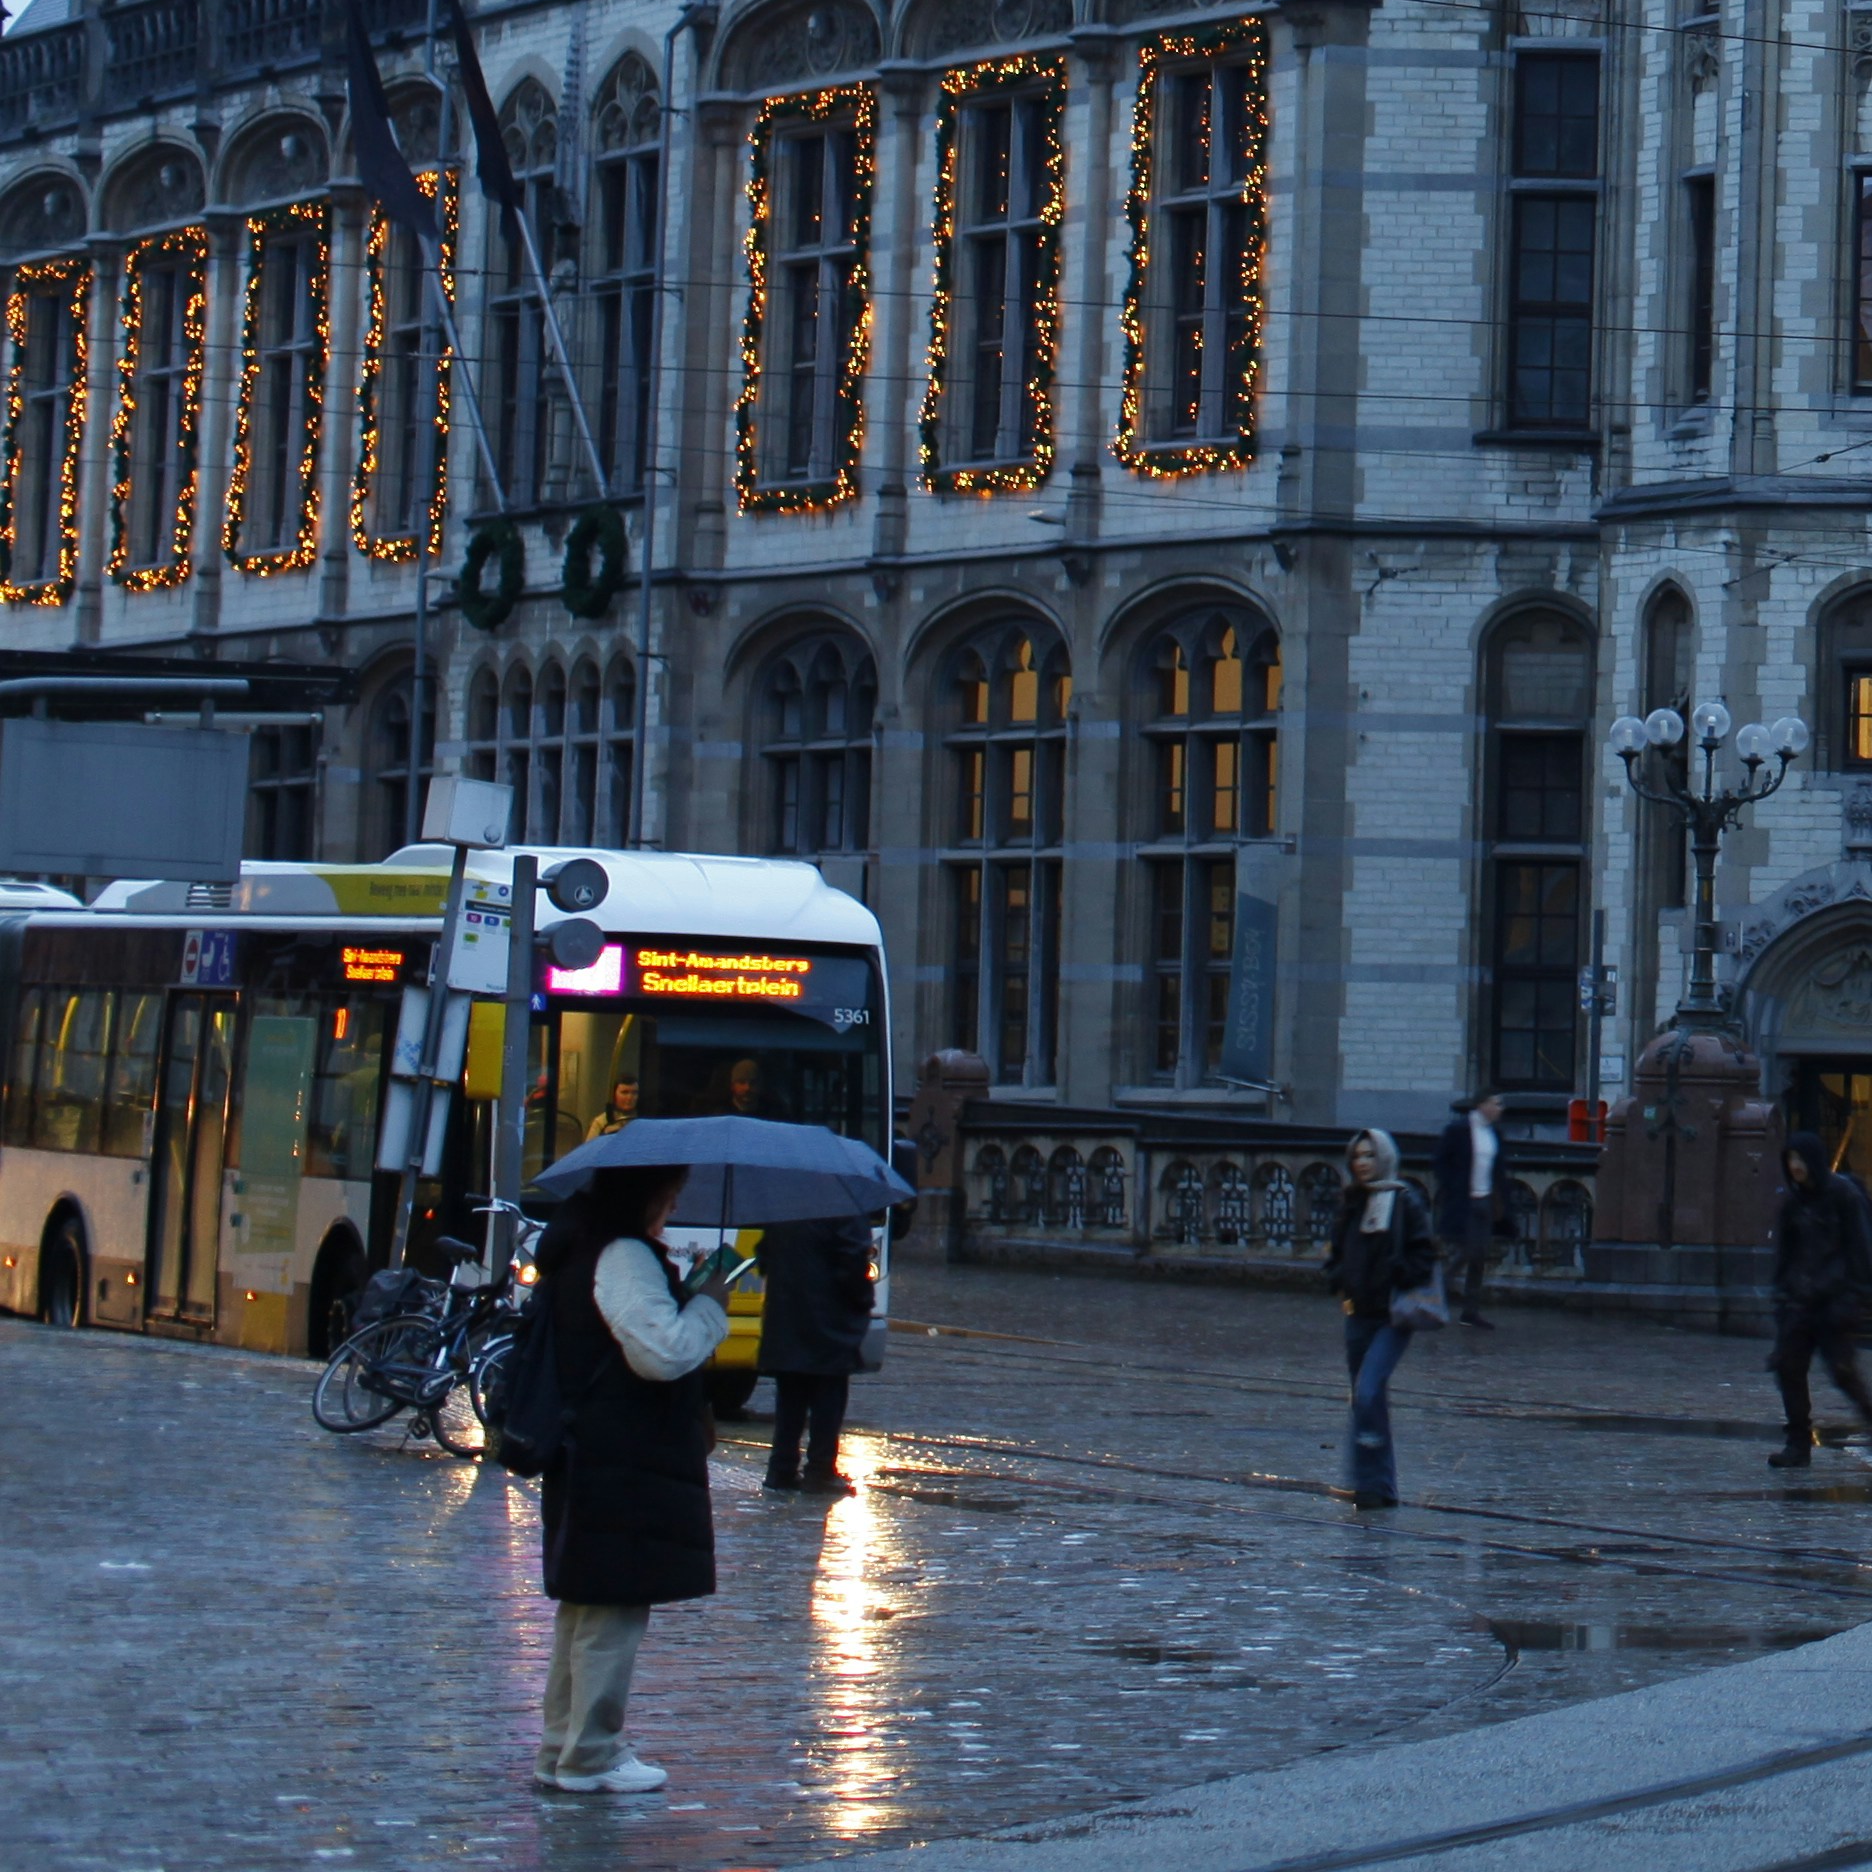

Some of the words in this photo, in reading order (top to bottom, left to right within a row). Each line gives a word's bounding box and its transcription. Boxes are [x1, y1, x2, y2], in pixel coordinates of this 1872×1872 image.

[637, 950, 810, 973] Sint-Amandsberg
[642, 972, 800, 997] Snellaertplein
[833, 1007, 870, 1025] 5361
